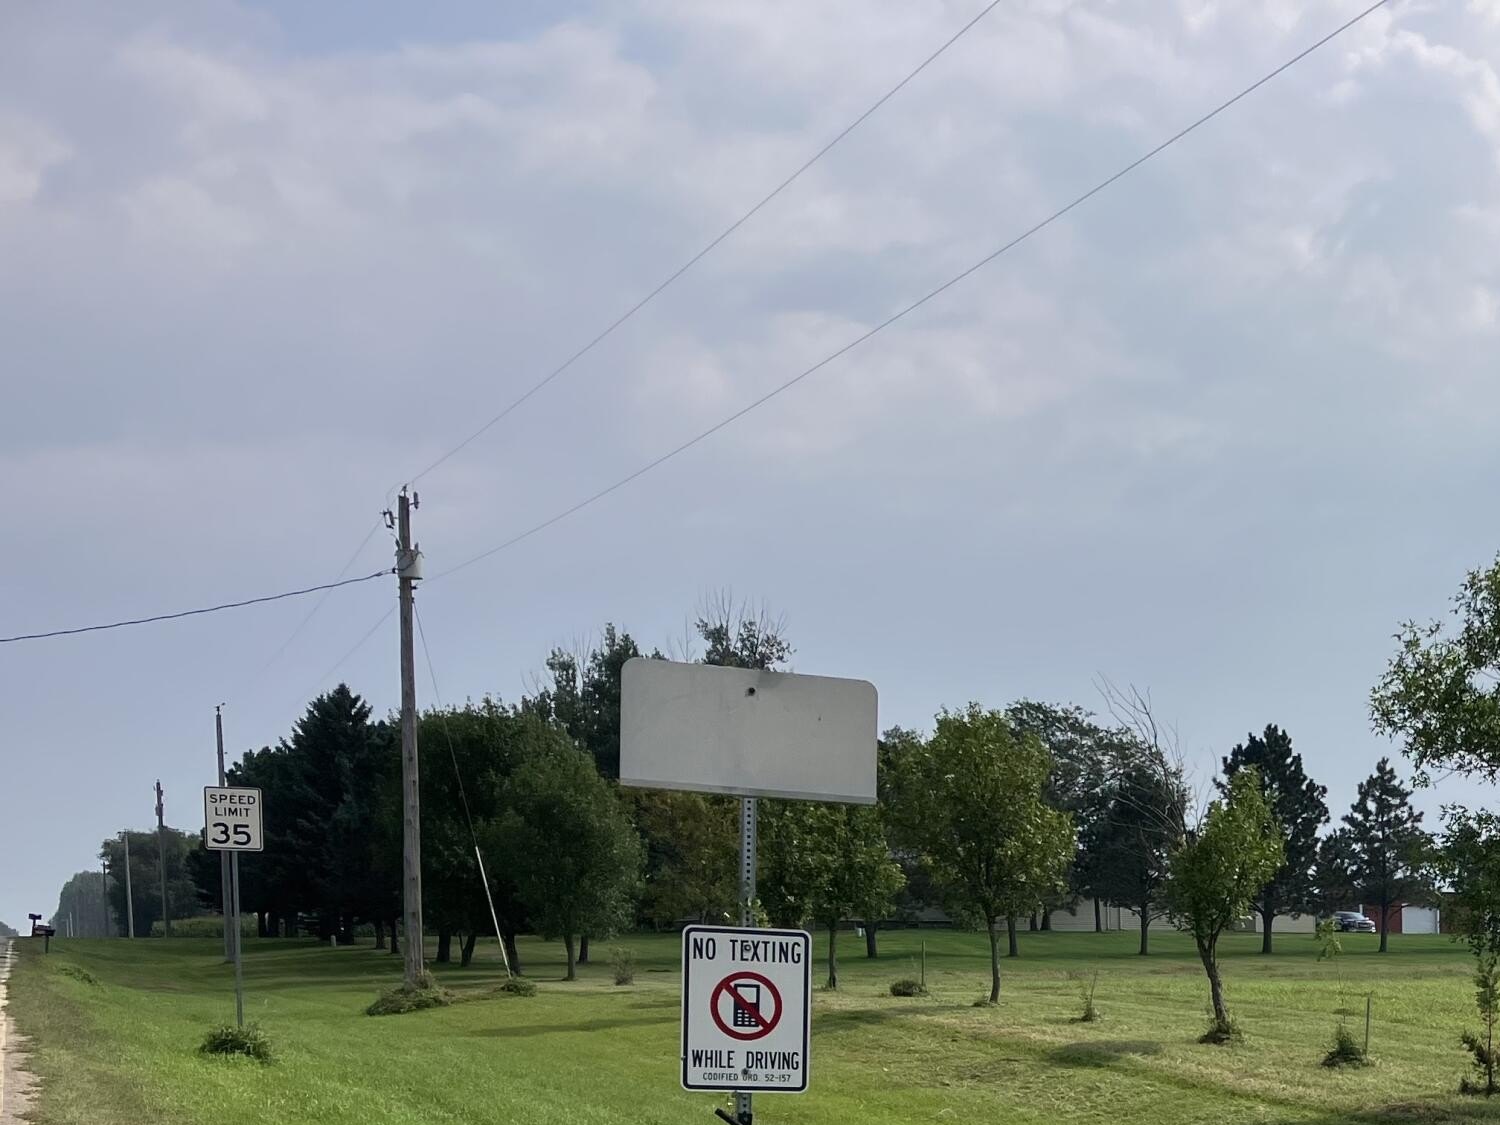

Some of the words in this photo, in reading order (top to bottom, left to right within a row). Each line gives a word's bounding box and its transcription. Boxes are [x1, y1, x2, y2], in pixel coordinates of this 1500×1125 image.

[209, 793, 256, 805] SPEED
[214, 806, 251, 817] LIMIT
[212, 822, 251, 846] 35
[692, 937, 716, 960] NO
[729, 939, 801, 964] TEXTING
[691, 1049, 735, 1068] WHILE
[746, 1051, 800, 1070] DRIVING
[702, 1072, 738, 1081] CODIFIED
[764, 1074, 791, 1082] 52-157
